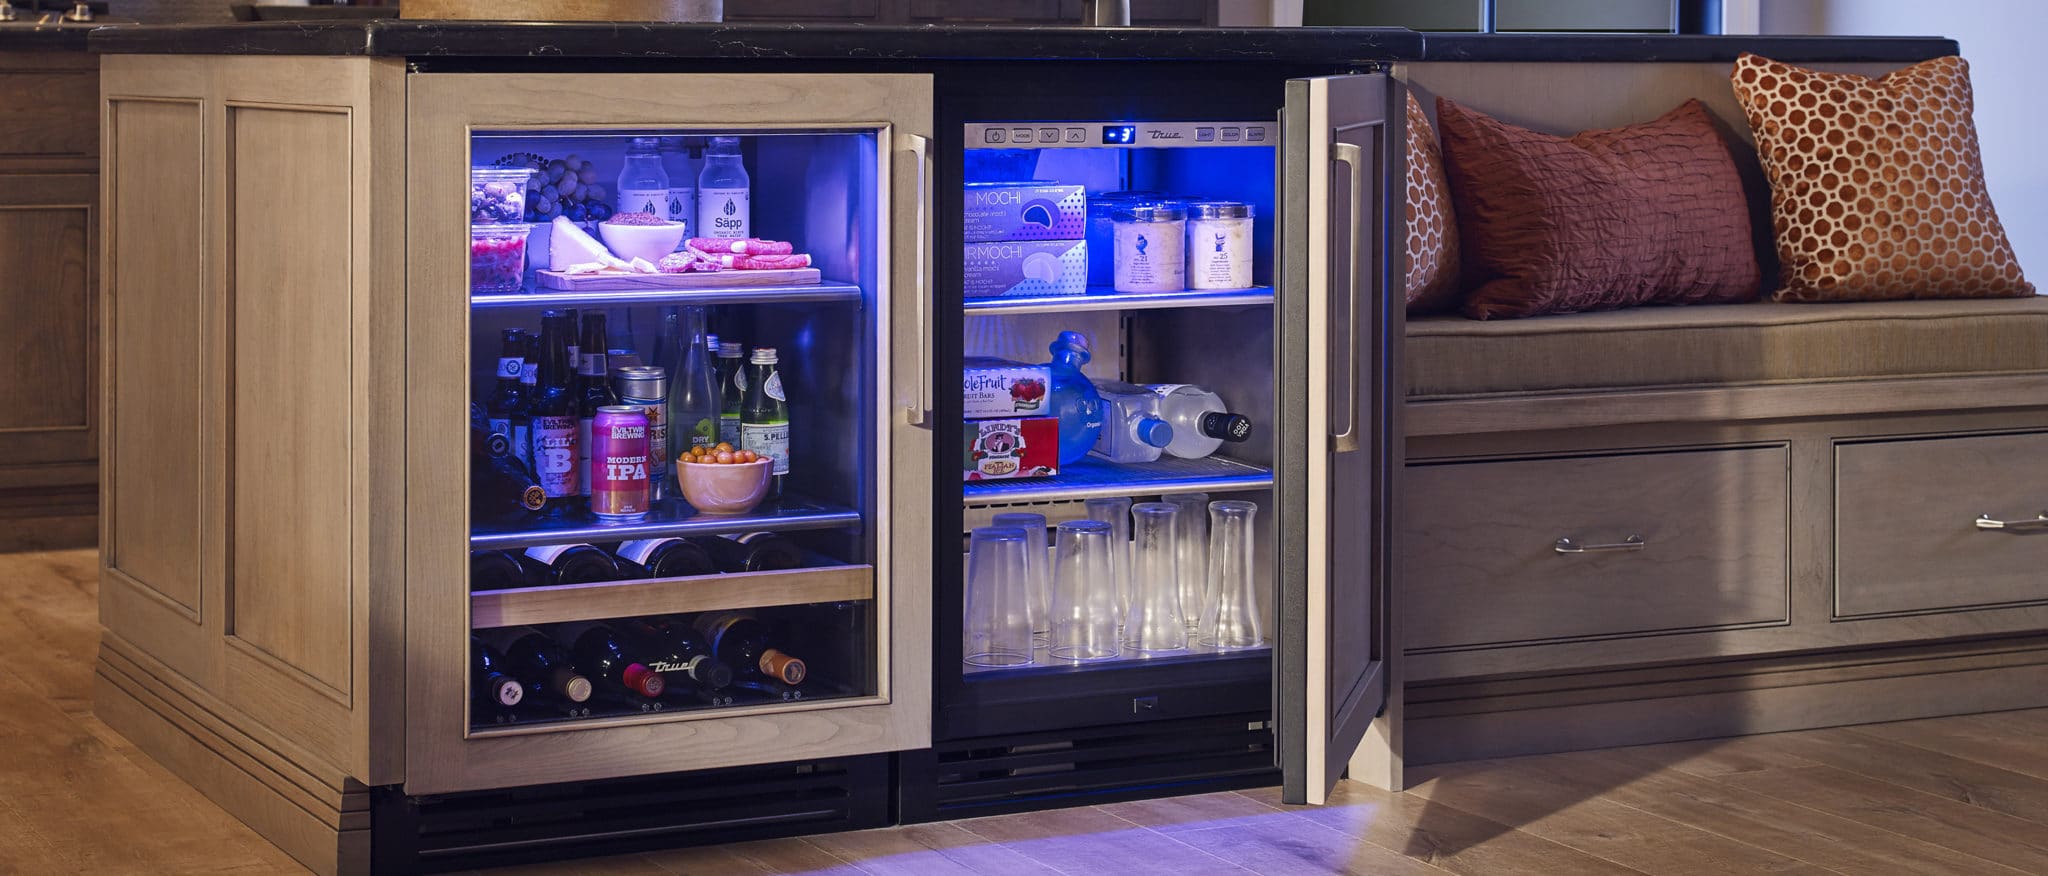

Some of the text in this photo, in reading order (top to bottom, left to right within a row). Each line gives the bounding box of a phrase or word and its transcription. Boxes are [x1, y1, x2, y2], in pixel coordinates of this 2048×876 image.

[976, 191, 1021, 205] MOCHI
[715, 217, 742, 230] Säpp
[964, 374, 1007, 391] oleFruit
[607, 456, 647, 464] MODERN
[607, 464, 647, 480] IPA
